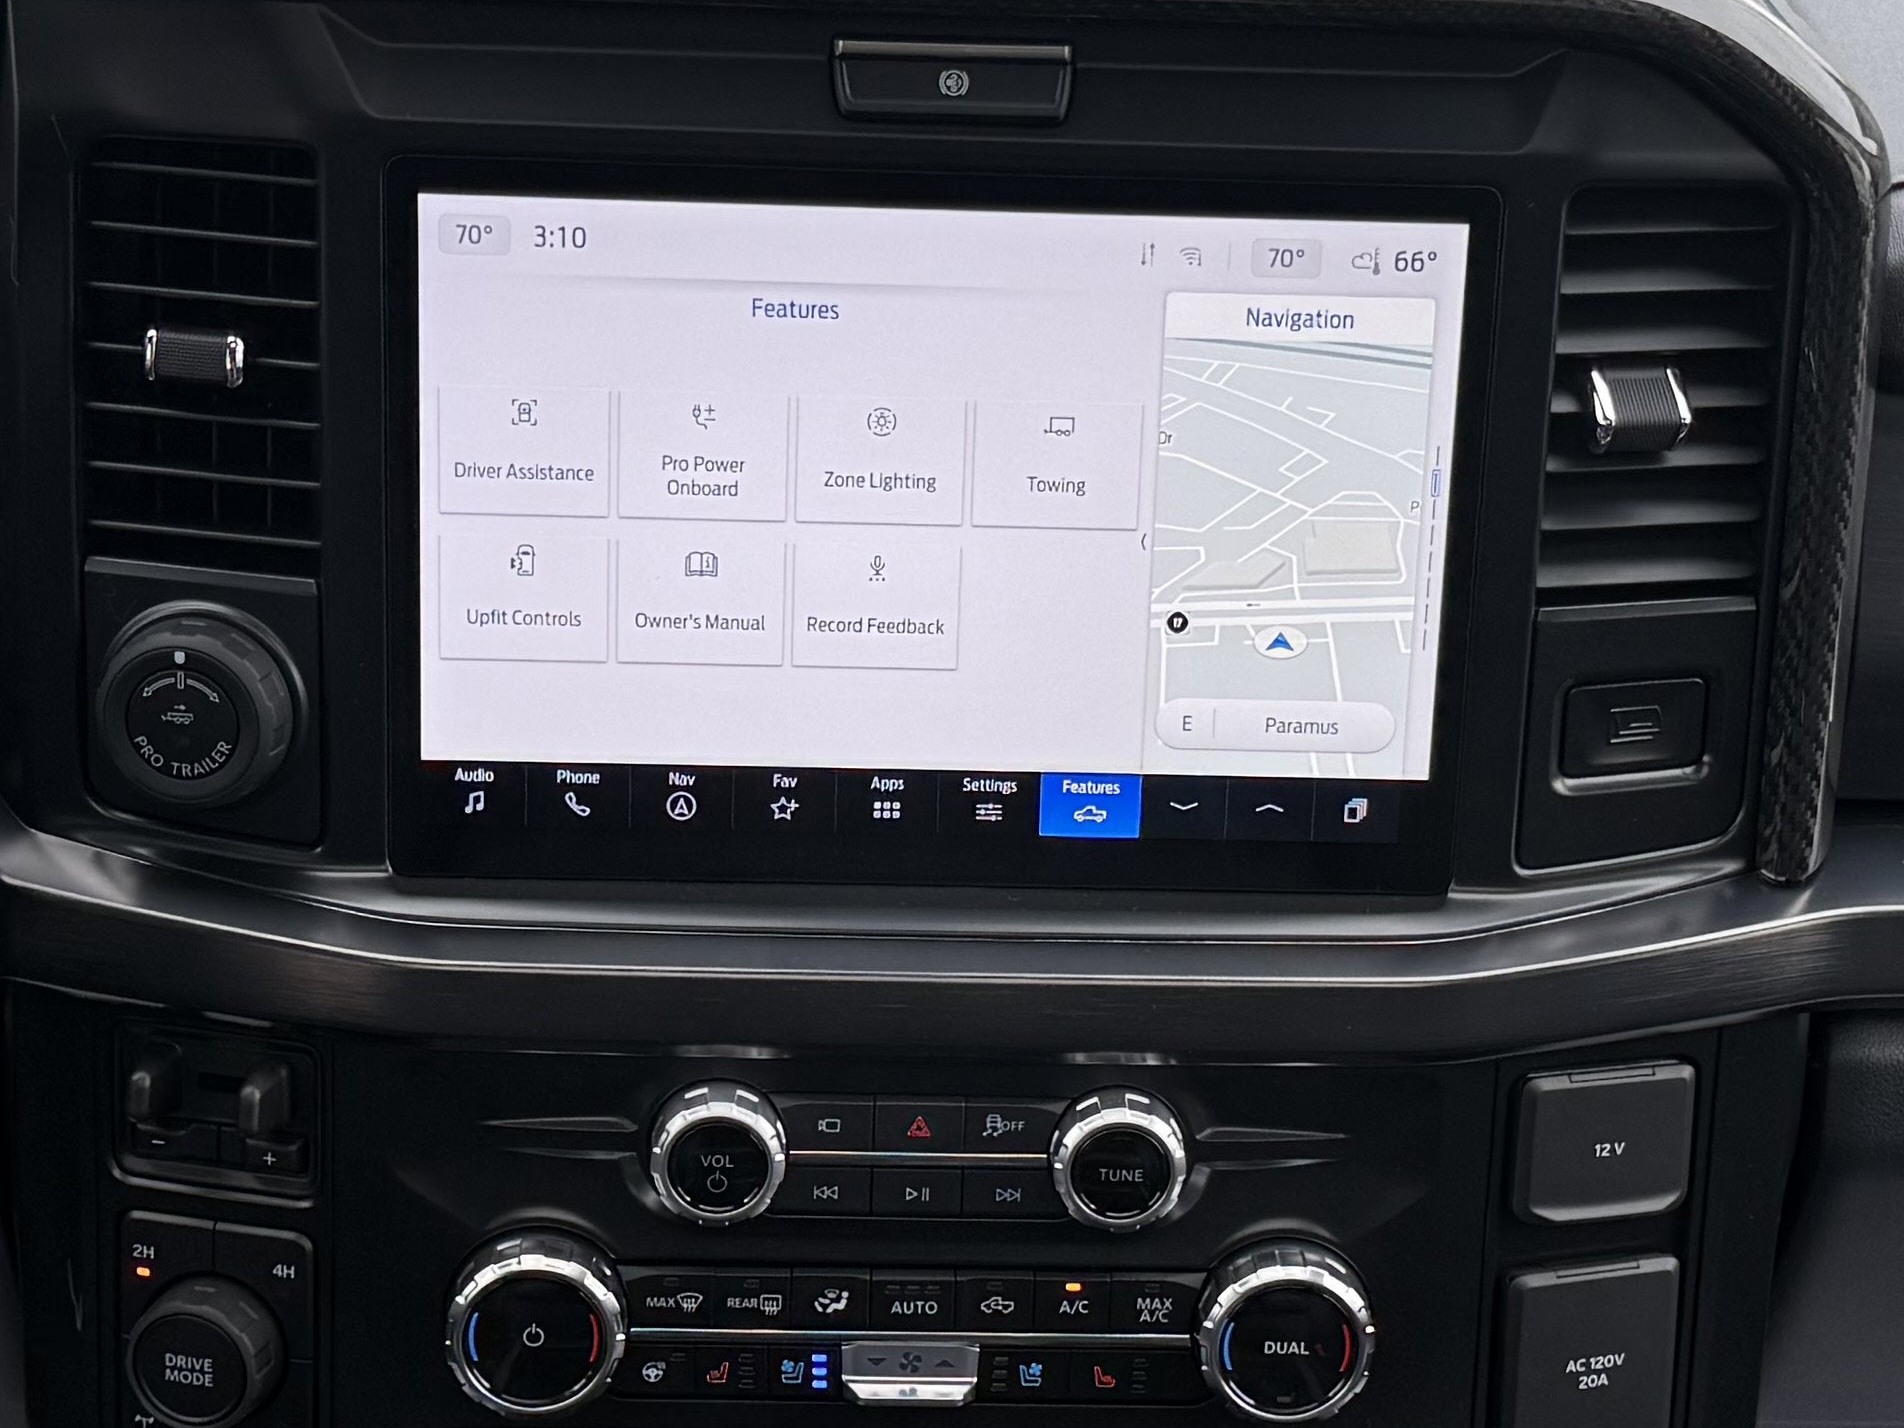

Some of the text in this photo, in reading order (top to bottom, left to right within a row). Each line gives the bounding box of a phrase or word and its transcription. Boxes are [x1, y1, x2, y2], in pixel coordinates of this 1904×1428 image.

[455, 224, 493, 245] 70°
[533, 225, 587, 250] 3:10
[1268, 247, 1305, 269] 70°
[1394, 250, 1437, 273] 66°
[751, 297, 840, 321] Features
[1245, 307, 1355, 332] Navigation
[453, 461, 595, 483] Driver Assistance
[662, 454, 746, 475] Pro Power
[667, 477, 739, 498] Onboard
[824, 471, 937, 495] Zone Lighting
[1027, 475, 1086, 497] Towing
[466, 608, 582, 629] Upfit Controls
[634, 611, 766, 633] Owner's Manual
[806, 614, 945, 638] Record Feedback
[1182, 715, 1192, 732] E
[1265, 716, 1339, 736] Paramus
[133, 734, 234, 779] PRO TRAILER
[455, 767, 494, 784] Audio
[557, 768, 601, 785] Phone
[669, 772, 695, 786] Nav
[773, 773, 798, 789] Fav
[871, 776, 904, 793] Apps
[962, 777, 1018, 795] Settings
[1062, 778, 1121, 796] Features
[1001, 1119, 1025, 1133] OFF
[1594, 1142, 1626, 1158] 12 V
[700, 1154, 734, 1169] VOL
[1099, 1168, 1144, 1183] TUNE
[132, 1244, 155, 1260] 2H
[272, 1263, 296, 1279] 4H
[646, 1295, 676, 1309] MAX
[727, 1296, 758, 1311] REAR
[891, 1299, 938, 1315] AUTO
[1059, 1299, 1089, 1316] A/C
[1136, 1297, 1173, 1312] MAX
[1139, 1309, 1169, 1324] A/C
[1264, 1340, 1310, 1356] DUAL
[164, 1353, 214, 1372] DRIVE
[1565, 1353, 1625, 1374] AC 120V
[165, 1368, 214, 1388] MODE
[1578, 1373, 1609, 1390] 20A
